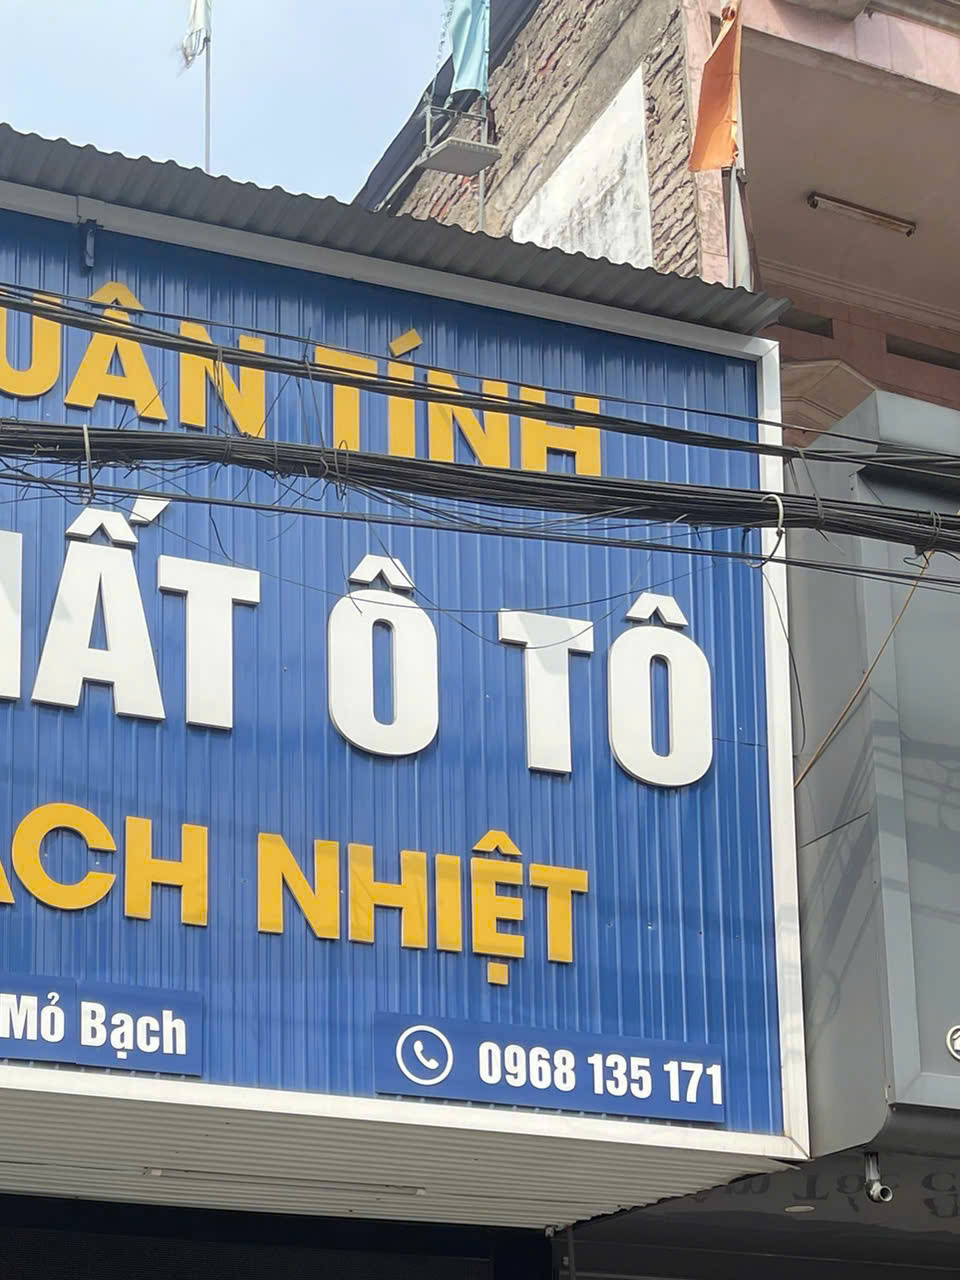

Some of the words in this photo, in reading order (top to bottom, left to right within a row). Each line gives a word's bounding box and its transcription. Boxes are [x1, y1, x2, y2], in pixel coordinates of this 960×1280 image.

[314, 327, 602, 478] TÍNH
[326, 553, 439, 757] Ô
[498, 592, 714, 789] TÔ
[257, 829, 590, 986] NHIỆT
[80, 1001, 188, 1060] Bạch
[478, 1040, 577, 1093] 0968
[587, 1053, 653, 1100] 135
[663, 1060, 724, 1106] 171
